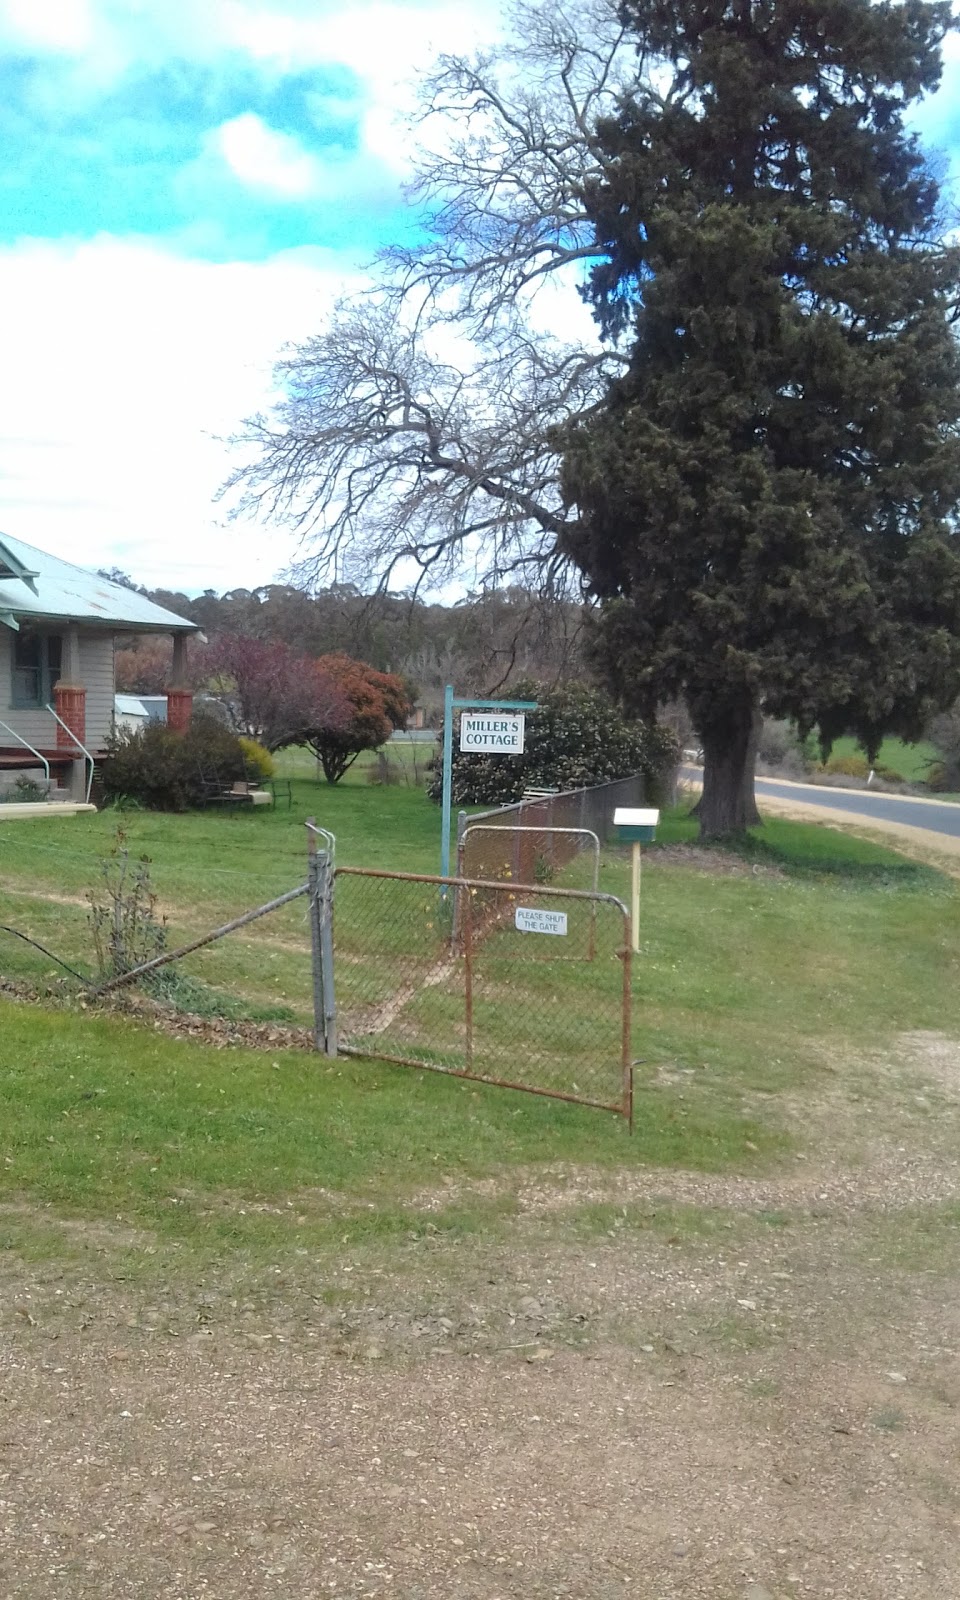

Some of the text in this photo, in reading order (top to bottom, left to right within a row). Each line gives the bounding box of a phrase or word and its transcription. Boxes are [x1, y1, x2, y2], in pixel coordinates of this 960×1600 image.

[466, 720, 519, 732] MILLER'S
[466, 733, 518, 746] COTTAGE
[518, 911, 565, 923] PLEASE SHUT
[524, 920, 558, 932] THE GATE
